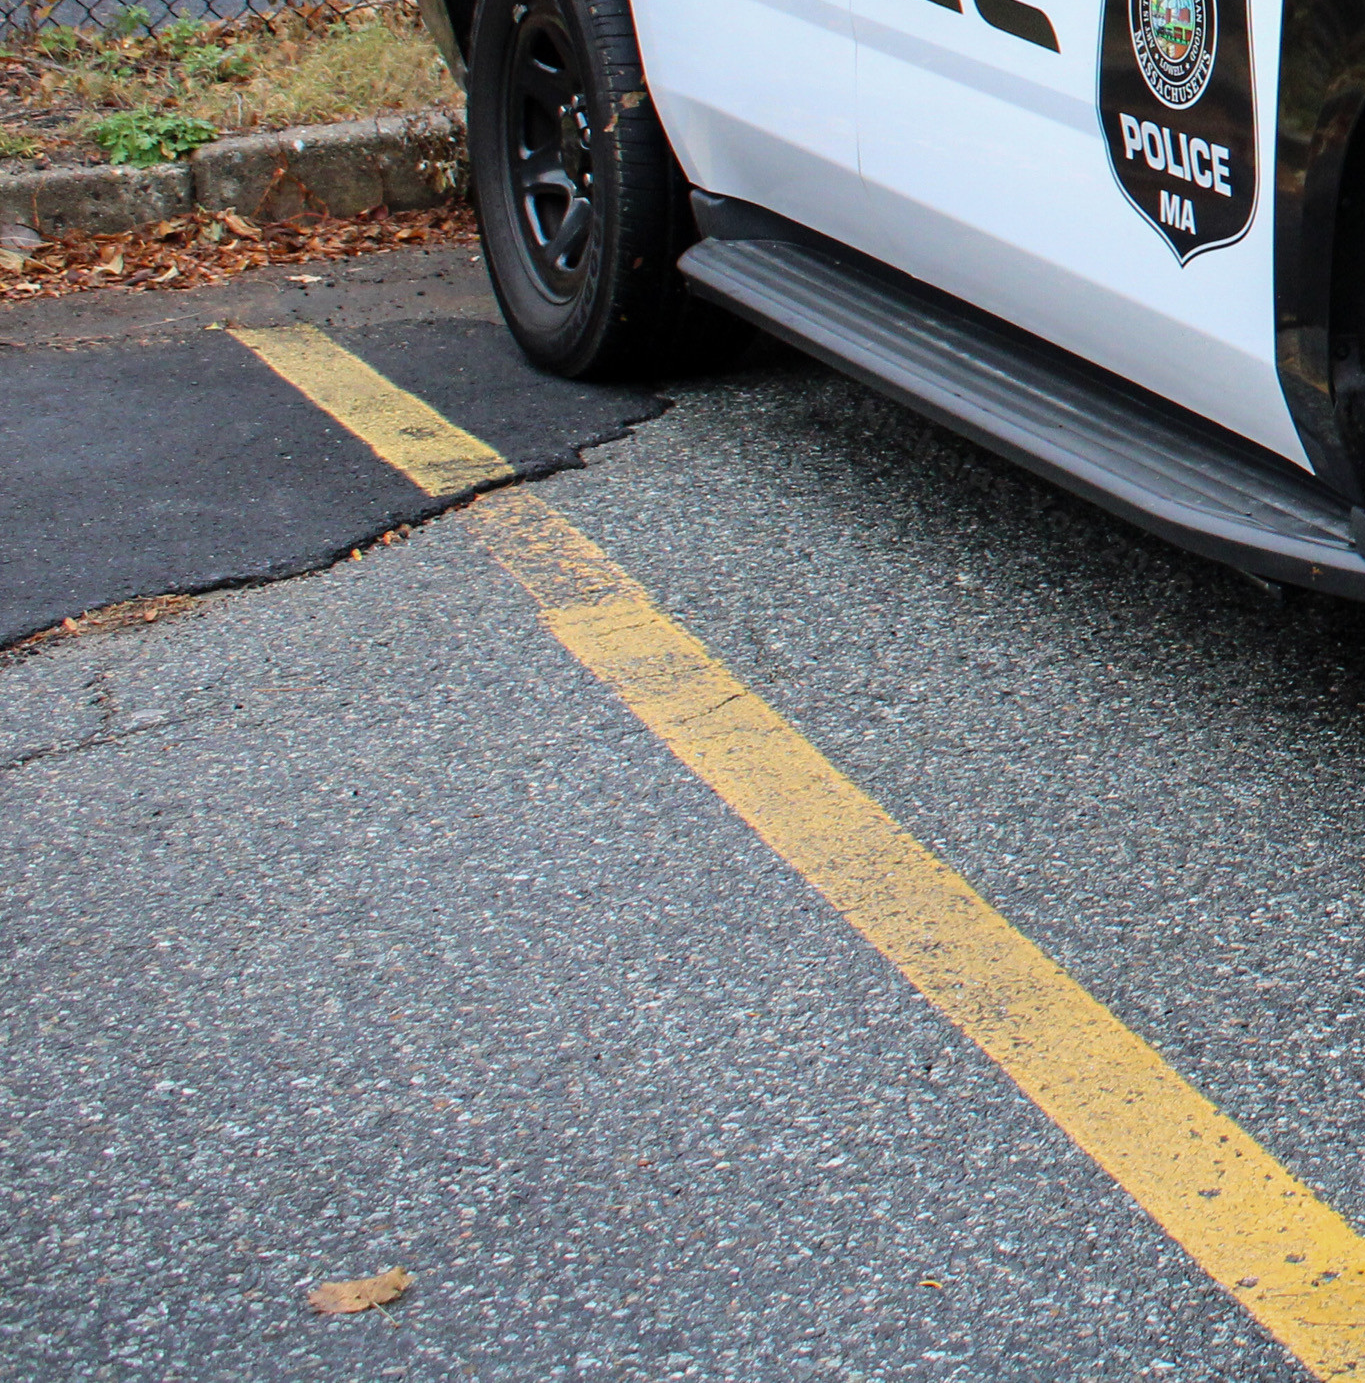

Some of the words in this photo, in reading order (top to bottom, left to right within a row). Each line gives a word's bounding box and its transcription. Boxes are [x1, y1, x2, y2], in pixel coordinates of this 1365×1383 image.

[1143, 10, 1149, 23] IS
[1145, 26, 1156, 49] ART
[1189, 26, 1202, 62] GOOD
[1134, 30, 1211, 103] MASSACHUSETTS
[1159, 57, 1185, 76] LOWELL
[1119, 112, 1232, 198] POLICE
[1160, 190, 1197, 235] MA
